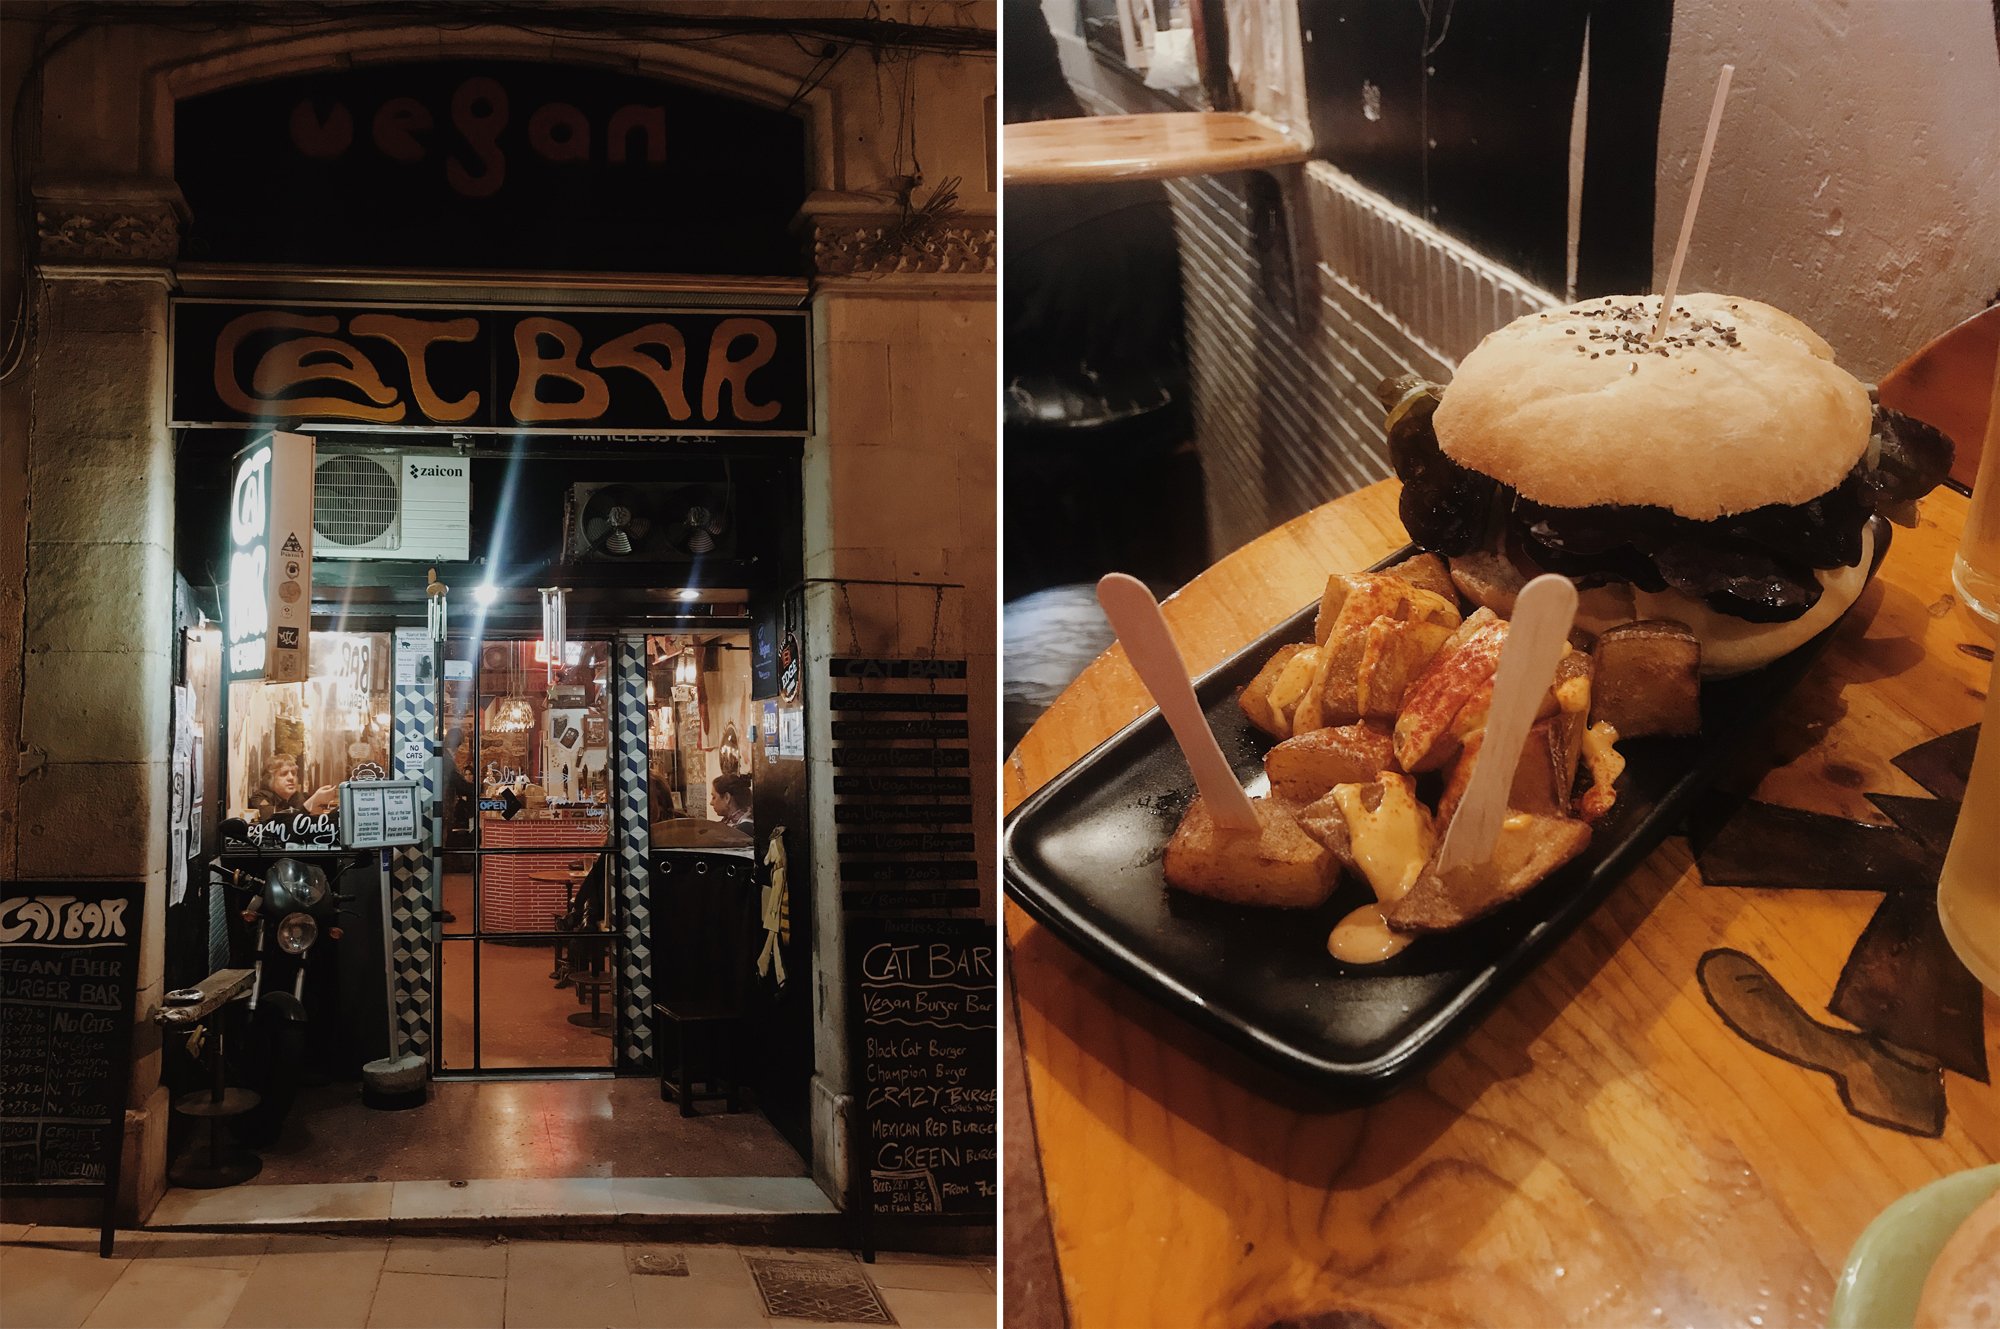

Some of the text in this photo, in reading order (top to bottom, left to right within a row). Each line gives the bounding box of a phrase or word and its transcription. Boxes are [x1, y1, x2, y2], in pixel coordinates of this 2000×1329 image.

[289, 76, 667, 198] vegan
[214, 310, 782, 423] CAT BAR
[420, 465, 463, 477] zaicon
[231, 446, 271, 546] CAT
[781, 659, 797, 690] EDGE
[844, 661, 960, 678] CAT BAR
[479, 801, 507, 810] OPEN
[247, 818, 290, 846] egan
[293, 814, 338, 845] Only
[0, 957, 122, 977] EGAN BEER
[862, 943, 994, 980] CAT BAR
[80, 983, 122, 1004] BAR
[863, 991, 992, 1020] Vegan Burger Bar
[866, 1037, 968, 1059] Black Cat Burger
[866, 1064, 928, 1086] Champion
[866, 1085, 996, 1111] CRAZY BURGE
[872, 1119, 920, 1139] MEXICAN
[925, 1117, 948, 1137] RED
[877, 1142, 996, 1170] GREEN BURG
[942, 1183, 969, 1199] FROM
